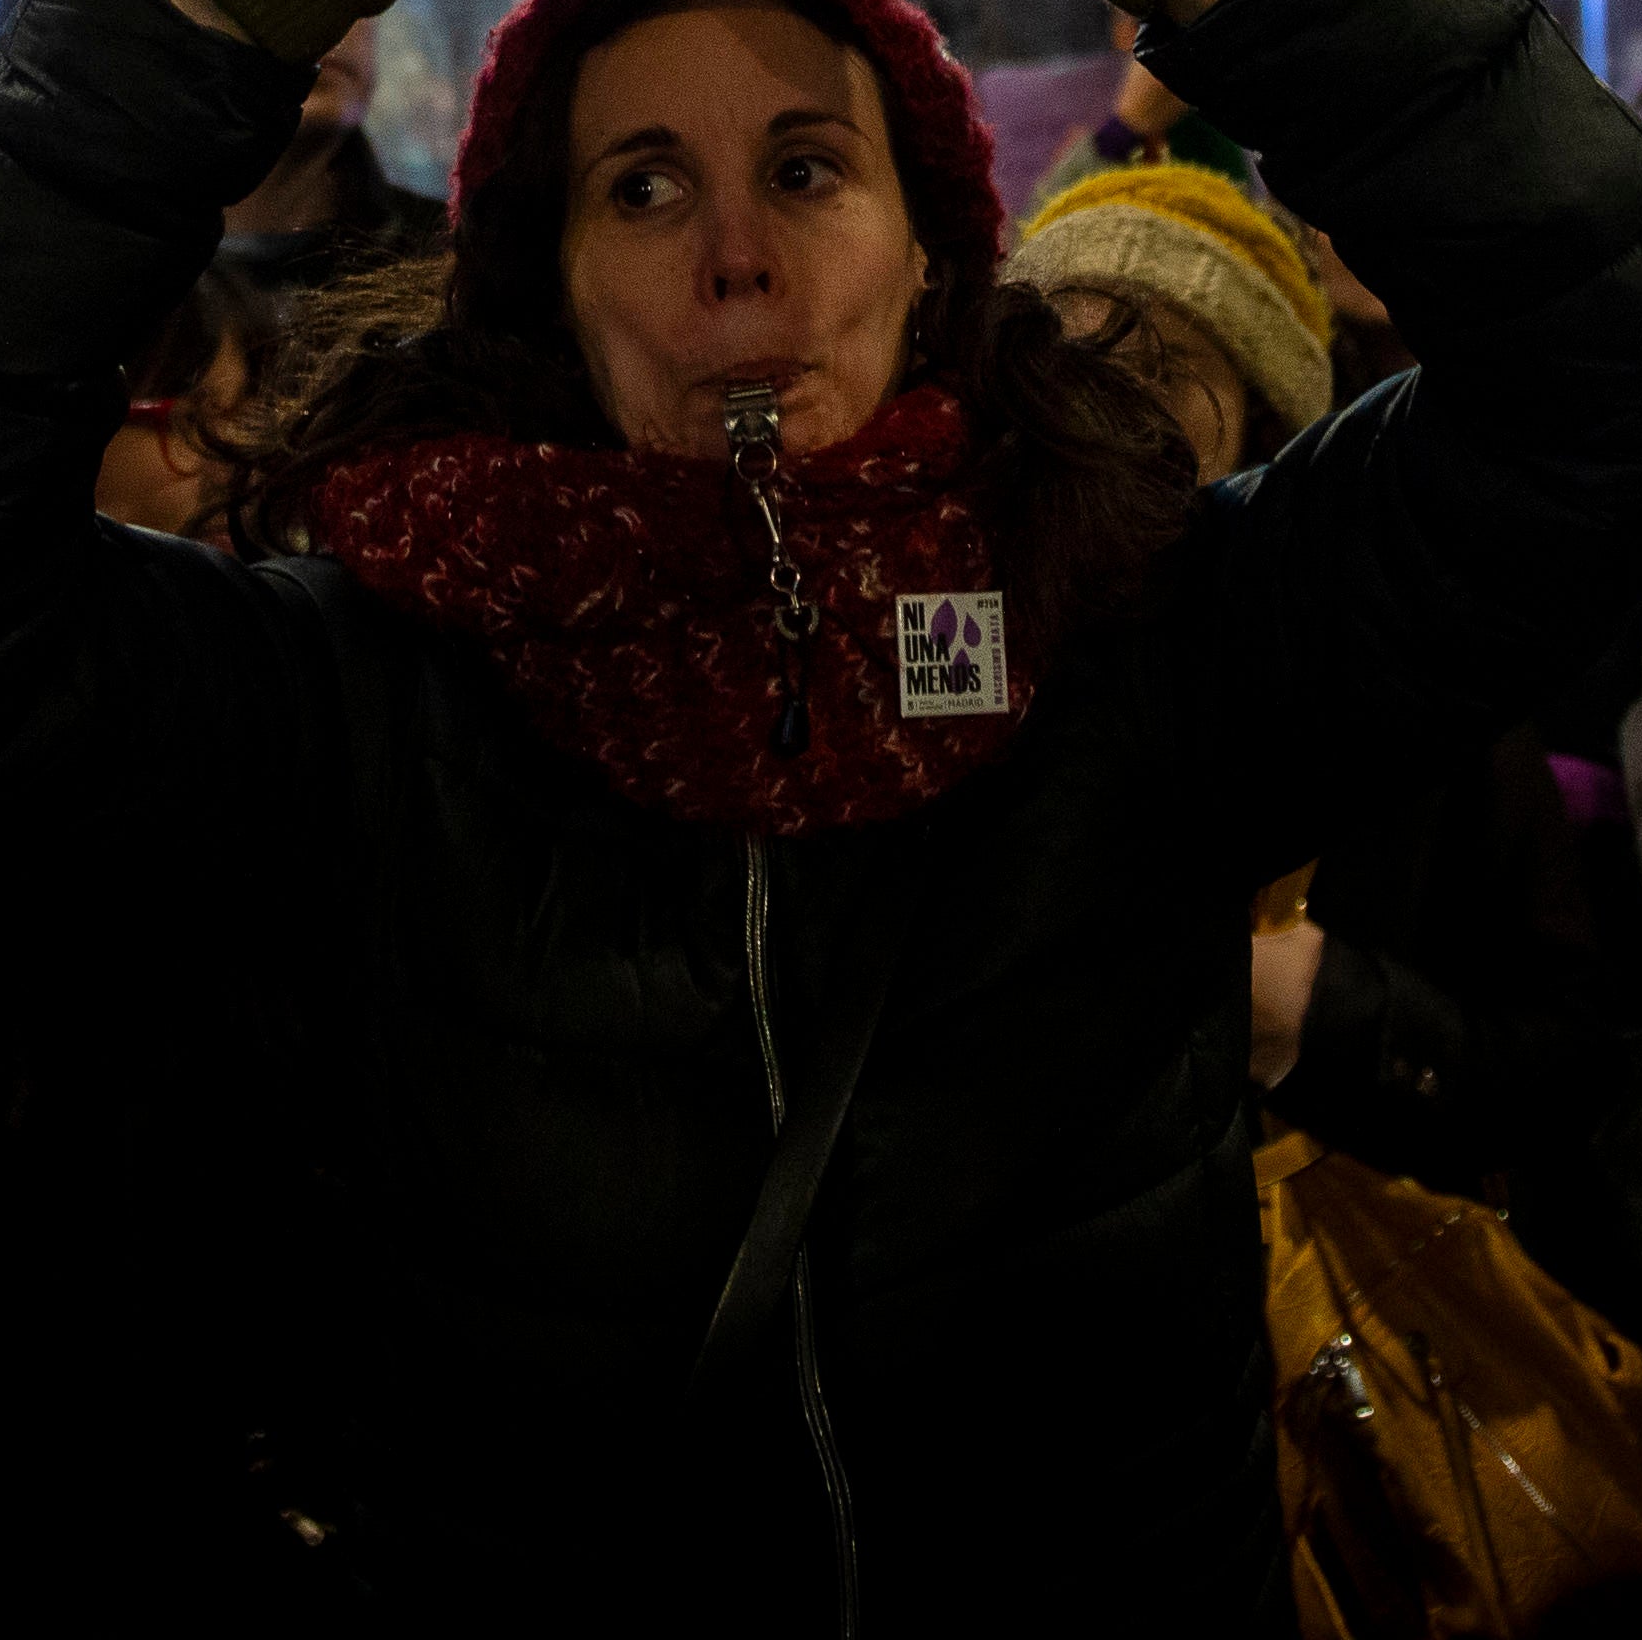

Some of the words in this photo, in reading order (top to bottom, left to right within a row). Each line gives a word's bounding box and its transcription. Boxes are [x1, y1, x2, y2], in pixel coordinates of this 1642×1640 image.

[902, 602, 925, 632] NI
[904, 633, 951, 663] UNA
[906, 663, 982, 696] MENOS
